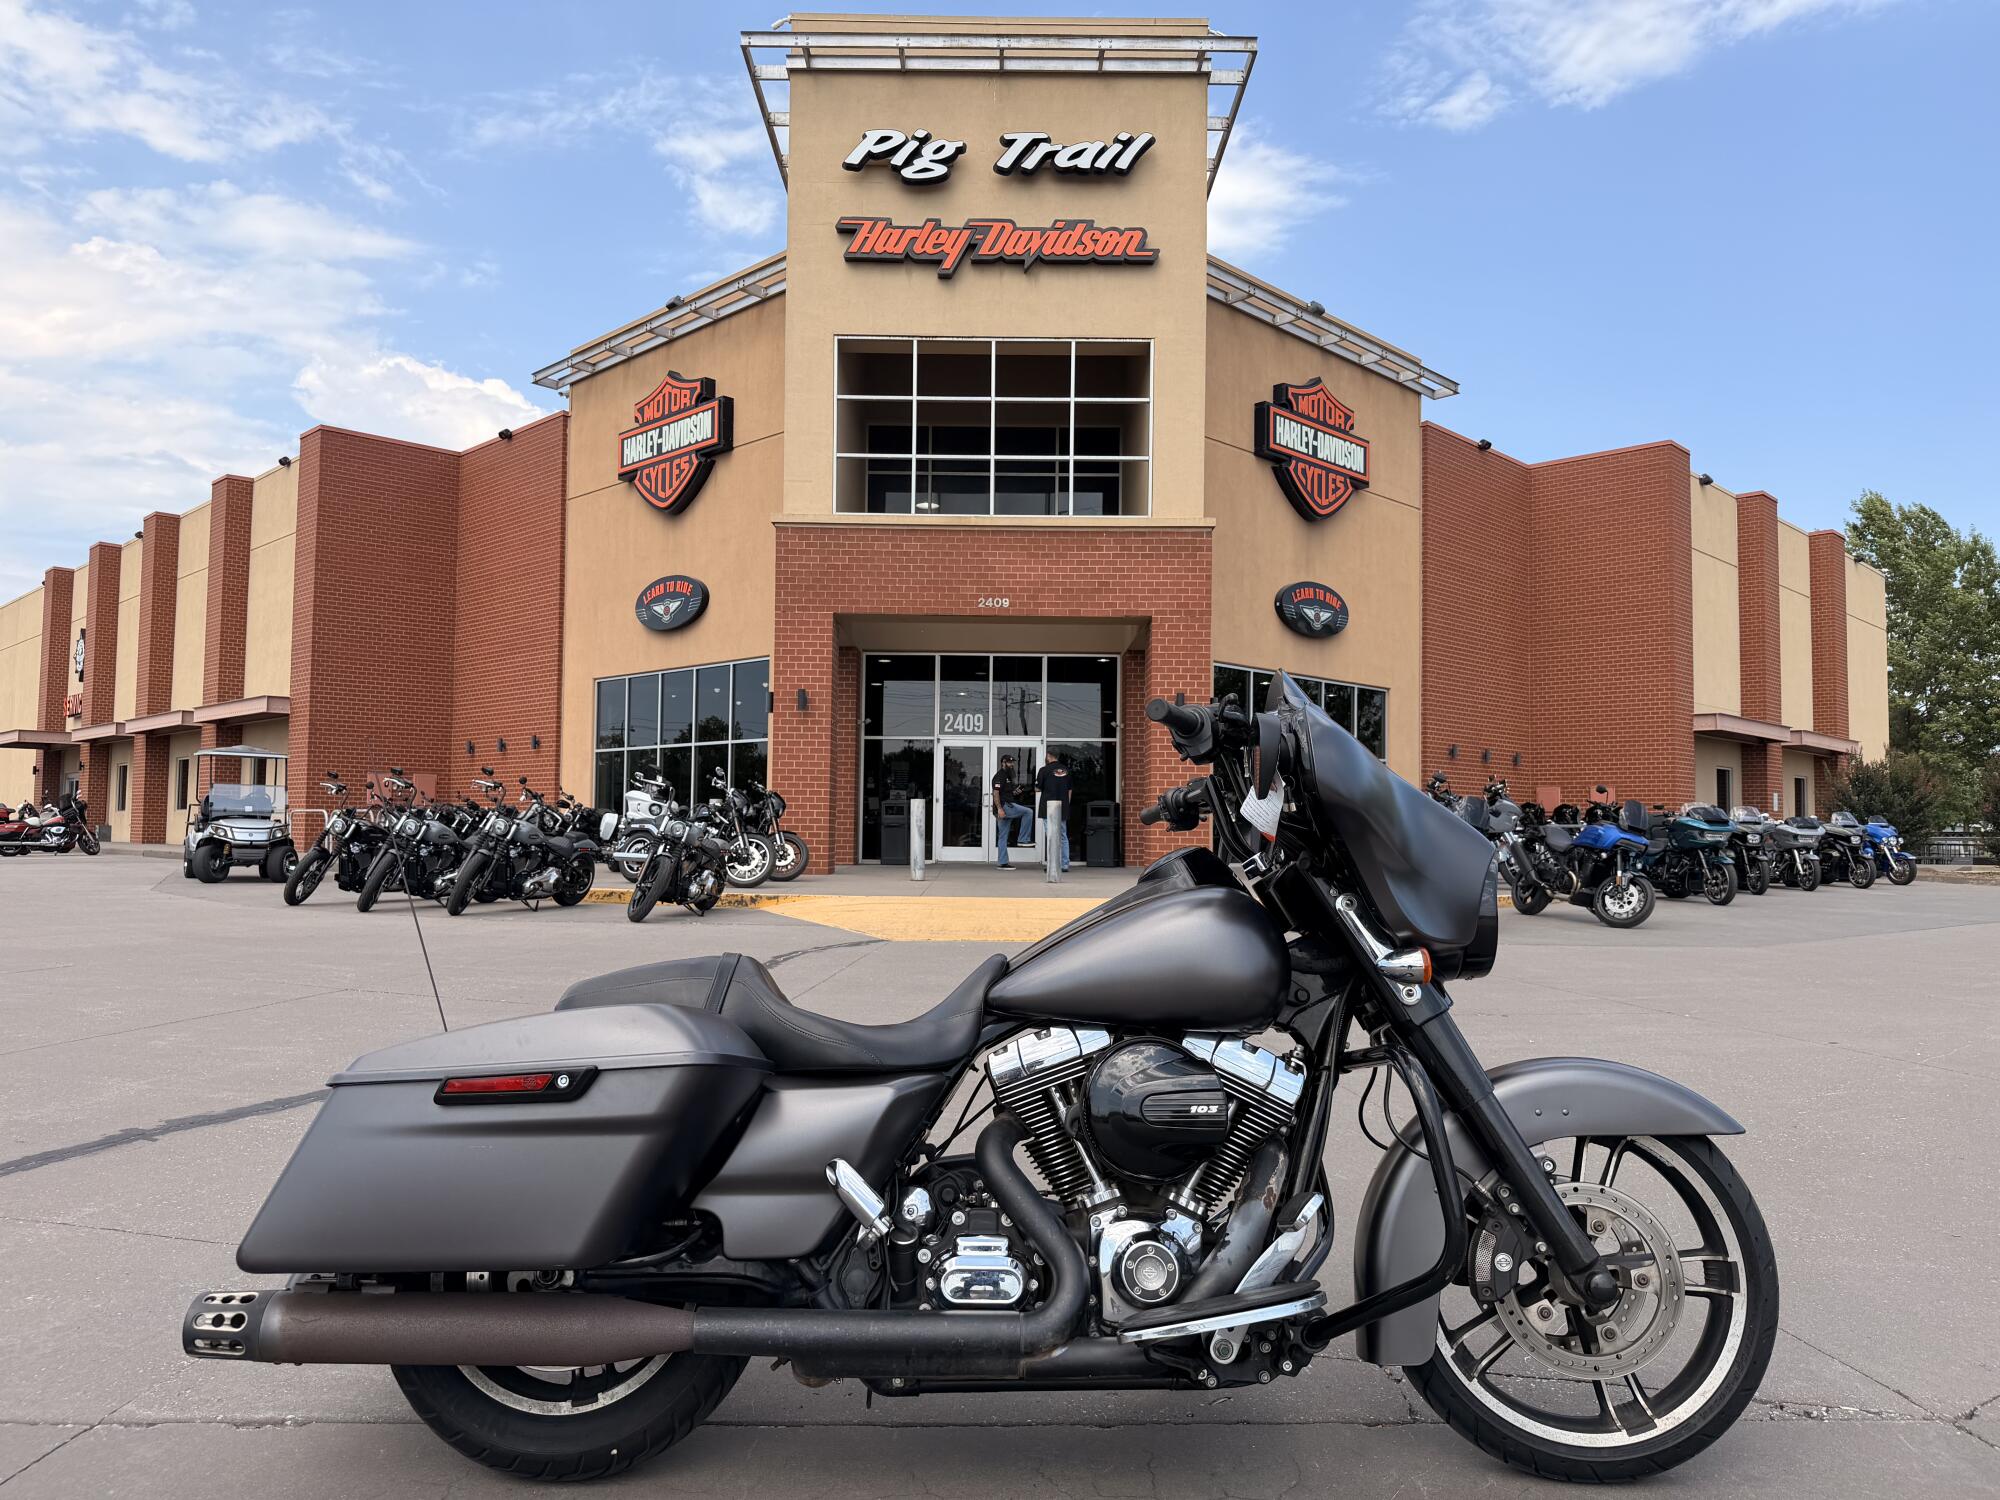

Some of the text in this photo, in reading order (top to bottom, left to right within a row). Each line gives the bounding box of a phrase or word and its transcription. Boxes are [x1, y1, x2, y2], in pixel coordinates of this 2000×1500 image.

[842, 129, 1155, 183] Pig Trail
[840, 218, 1155, 271] Harley-Davidson
[643, 384, 691, 423] MOTOR
[1298, 391, 1346, 429] MOTOR
[623, 409, 712, 466] HARLEY-DAVIDSON
[1275, 415, 1365, 474] HARLEY-DAVIDSON
[642, 456, 690, 499] CYCLES
[1297, 463, 1345, 506] CYCLES
[643, 580, 693, 605] LEARN TO RIDE
[977, 597, 1010, 608] 2409
[1292, 587, 1342, 611] LEARN TO RIDE
[944, 713, 984, 733] 2409
[1190, 1105, 1219, 1114] 103
